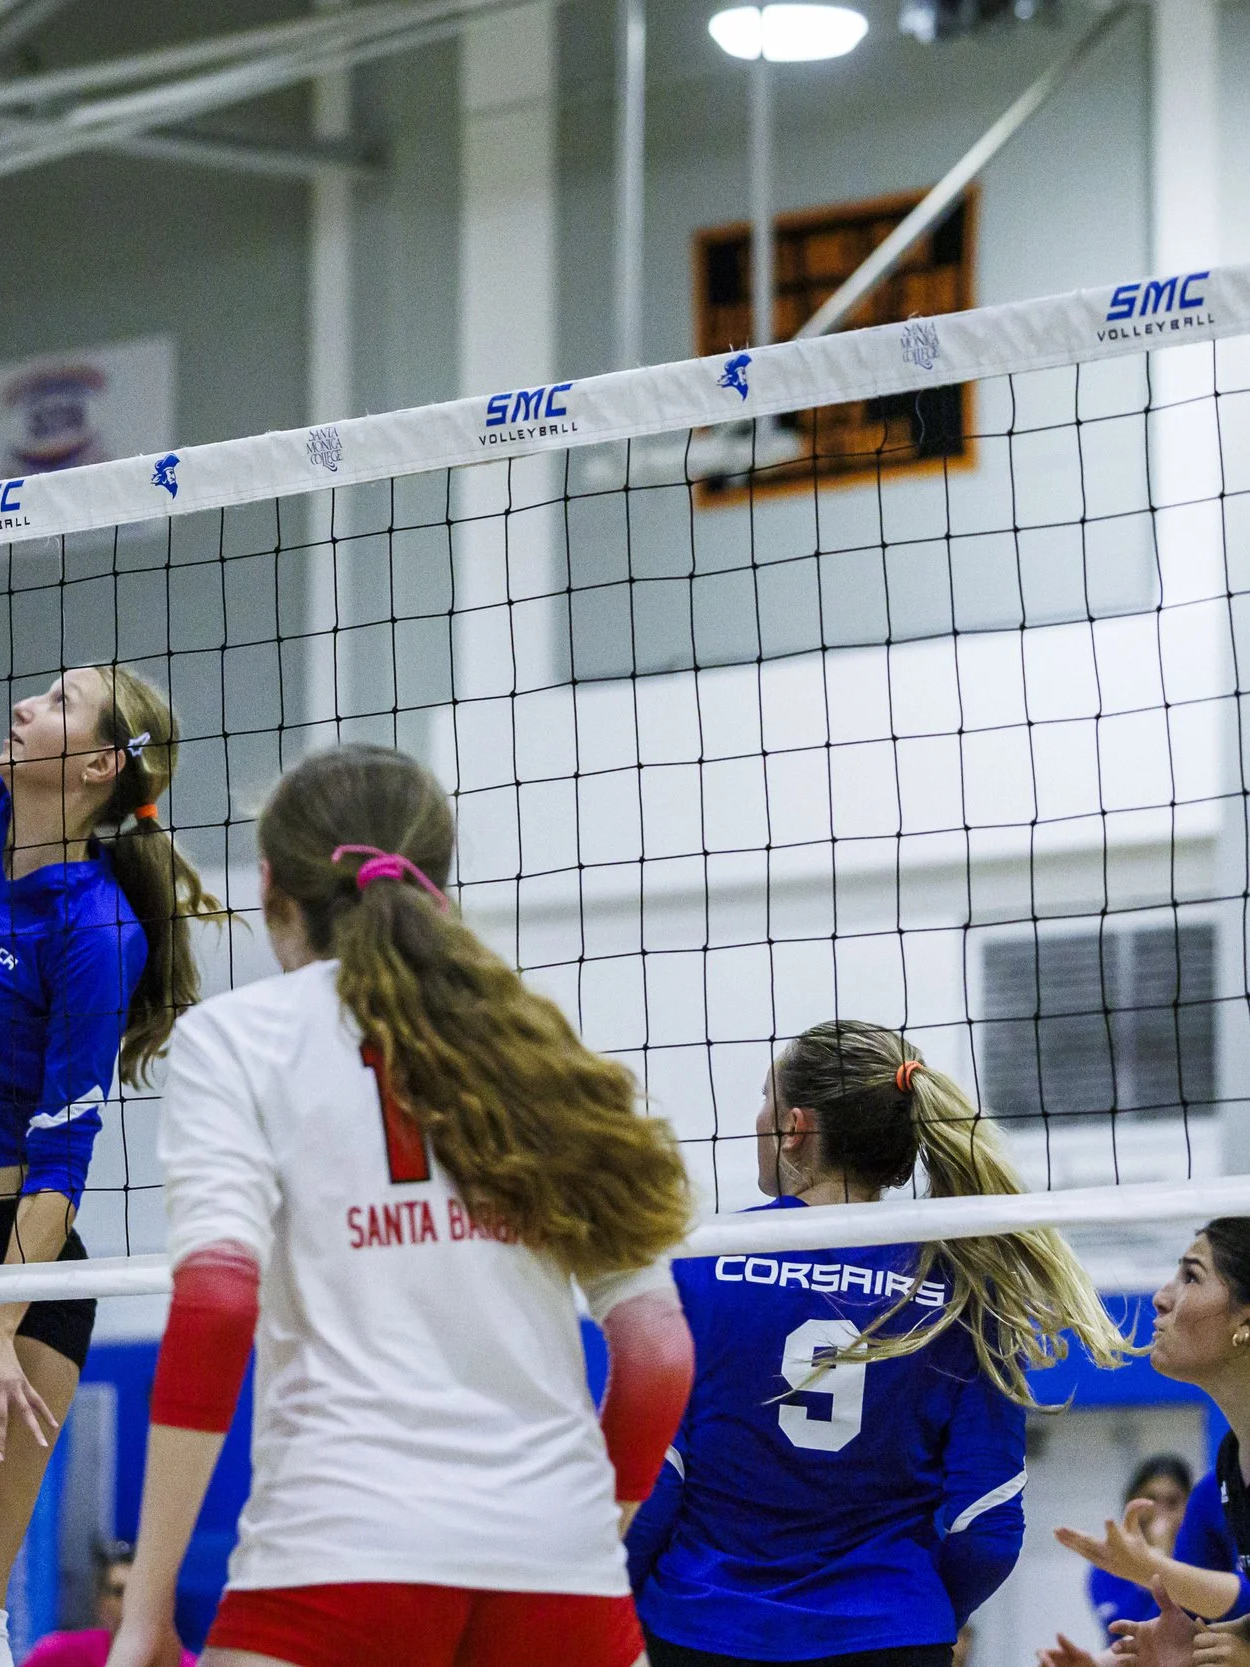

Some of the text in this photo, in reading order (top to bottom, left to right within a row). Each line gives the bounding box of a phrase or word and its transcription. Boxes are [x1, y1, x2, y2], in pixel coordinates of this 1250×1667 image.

[1106, 271, 1210, 322] SMC
[1097, 313, 1215, 342] VOLLEYBALL
[486, 383, 574, 427] SMC
[479, 422, 578, 445] VOLLEYBALL
[347, 1200, 438, 1250] SANTA
[715, 1255, 945, 1307] CORSAIRS
[778, 1318, 868, 1452] 9
